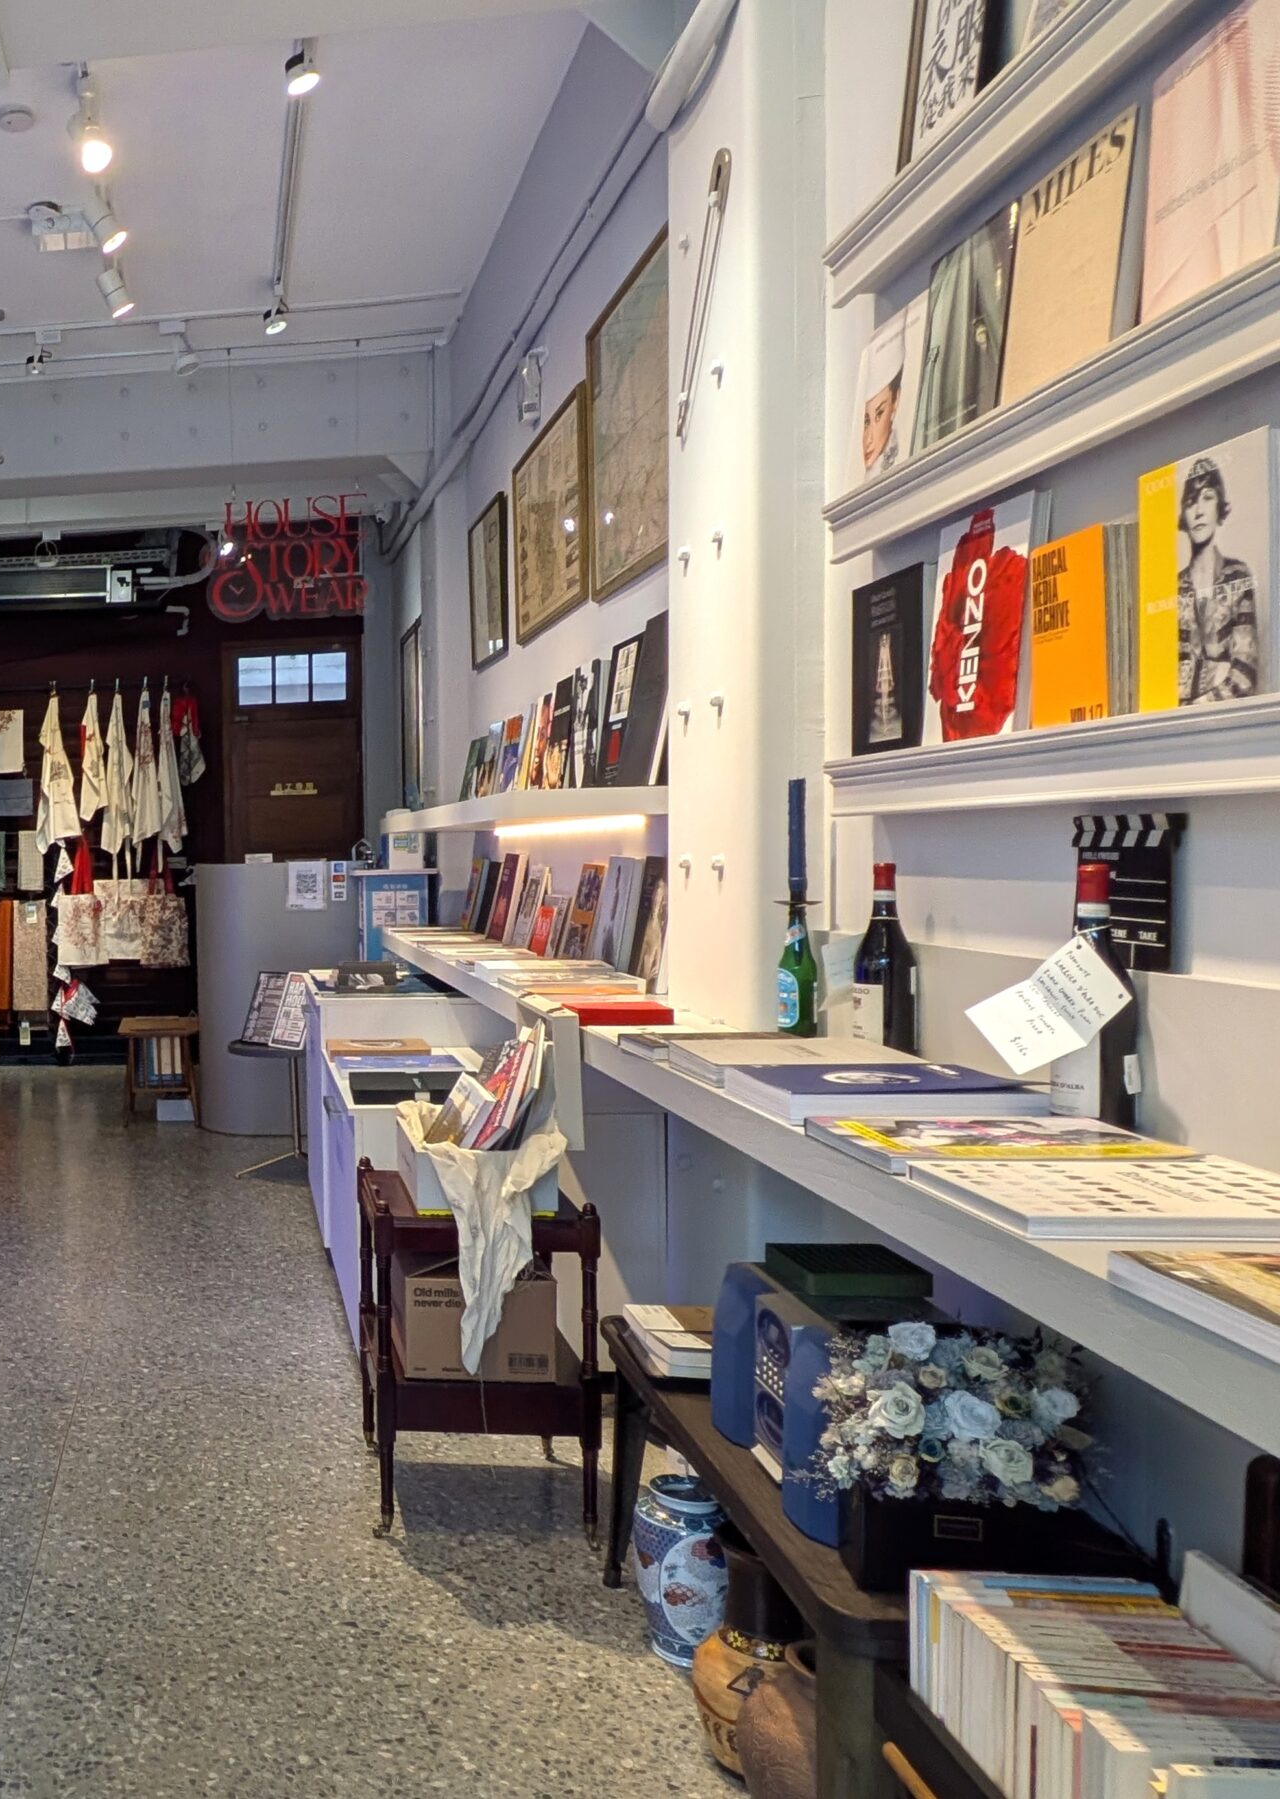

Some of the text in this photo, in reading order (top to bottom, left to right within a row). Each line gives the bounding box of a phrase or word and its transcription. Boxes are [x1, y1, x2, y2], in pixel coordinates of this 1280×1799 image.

[1024, 118, 1128, 235] MILES
[224, 493, 368, 543] HOUSE
[1032, 546, 1068, 583] RADICAL
[264, 579, 369, 613] WEAR
[1032, 576, 1059, 610] MEDIA
[956, 558, 988, 713] KENZO
[1032, 600, 1070, 636] ARCHIVE
[1138, 930, 1158, 941] TAKE
[413, 1287, 432, 1298] Old
[414, 1298, 461, 1308] never die
